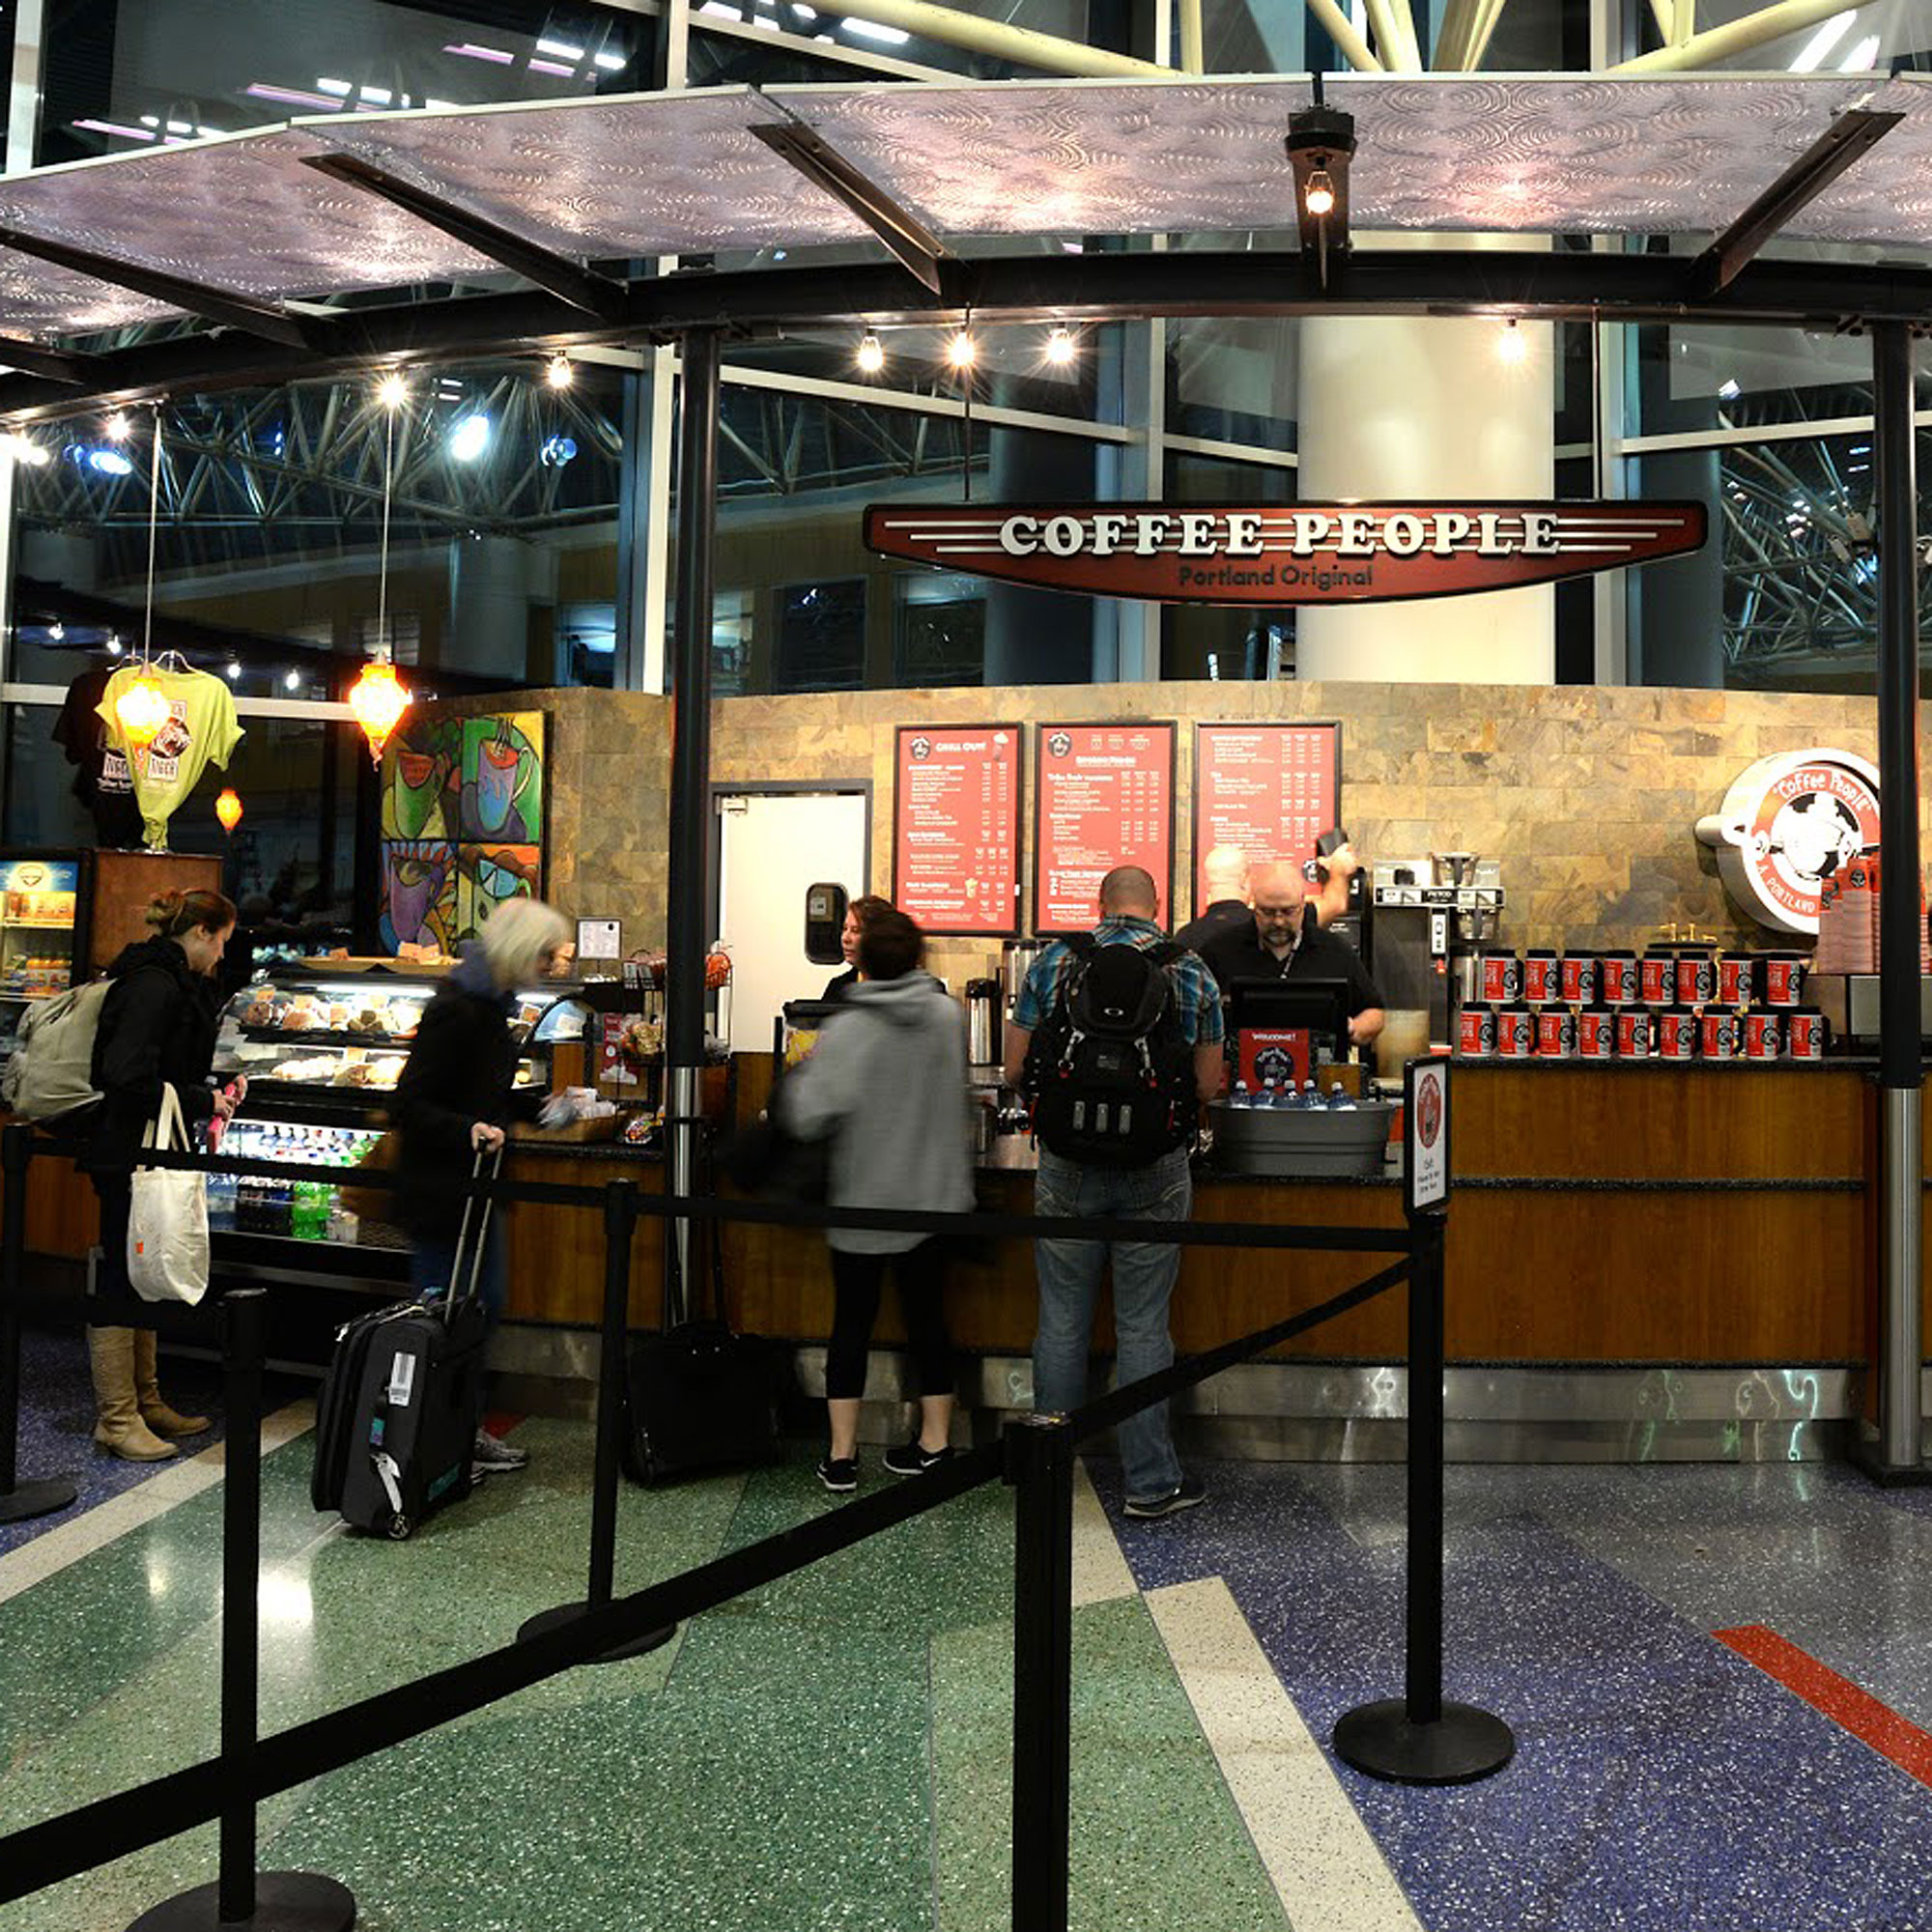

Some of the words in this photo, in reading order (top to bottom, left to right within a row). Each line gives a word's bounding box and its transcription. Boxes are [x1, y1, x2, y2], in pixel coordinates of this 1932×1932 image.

[998, 514, 1264, 558] COFFEE
[1293, 513, 1562, 557] PEOPLE
[1179, 565, 1279, 586] Portland
[1281, 565, 1374, 589] Original
